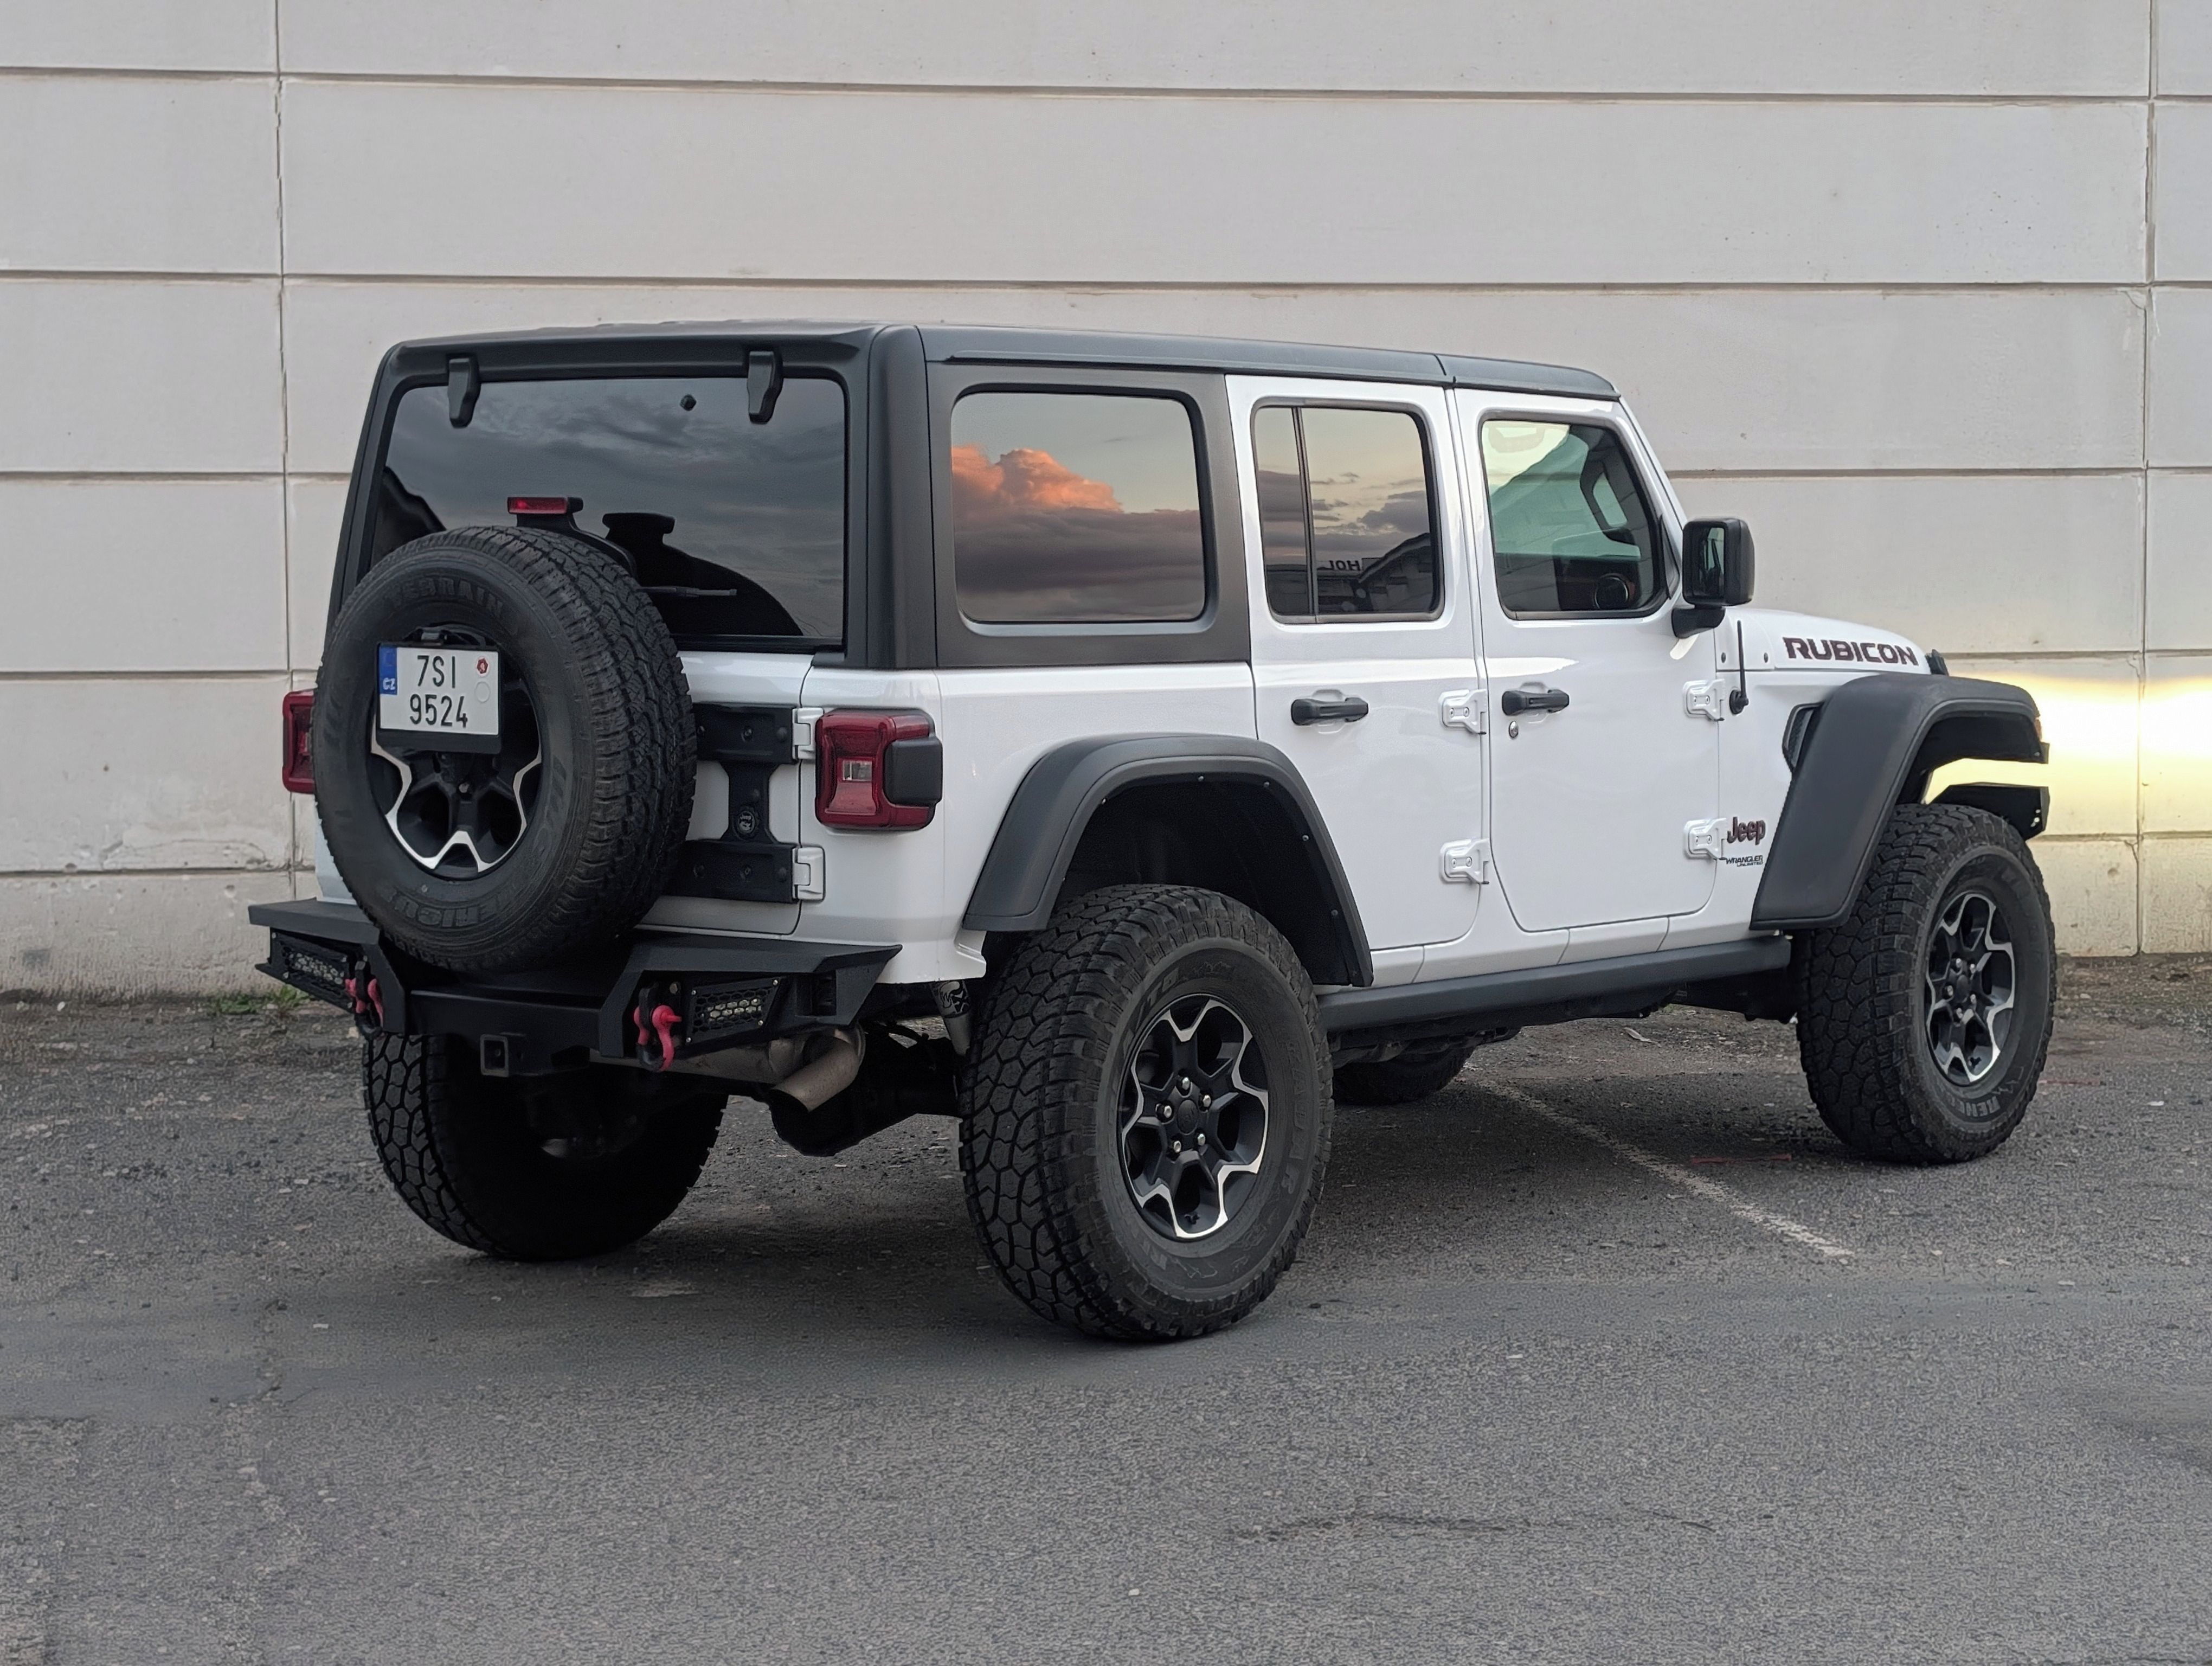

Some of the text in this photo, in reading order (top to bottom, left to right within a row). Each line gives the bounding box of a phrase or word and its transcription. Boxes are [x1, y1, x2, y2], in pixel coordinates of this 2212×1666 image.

[1783, 637, 1919, 666] RUBICON
[383, 677, 396, 690] CZ
[417, 655, 455, 689] 7SI
[410, 694, 468, 728] 9524
[1727, 817, 1766, 846] Jeep
[1726, 855, 1764, 864] WRANGLER
